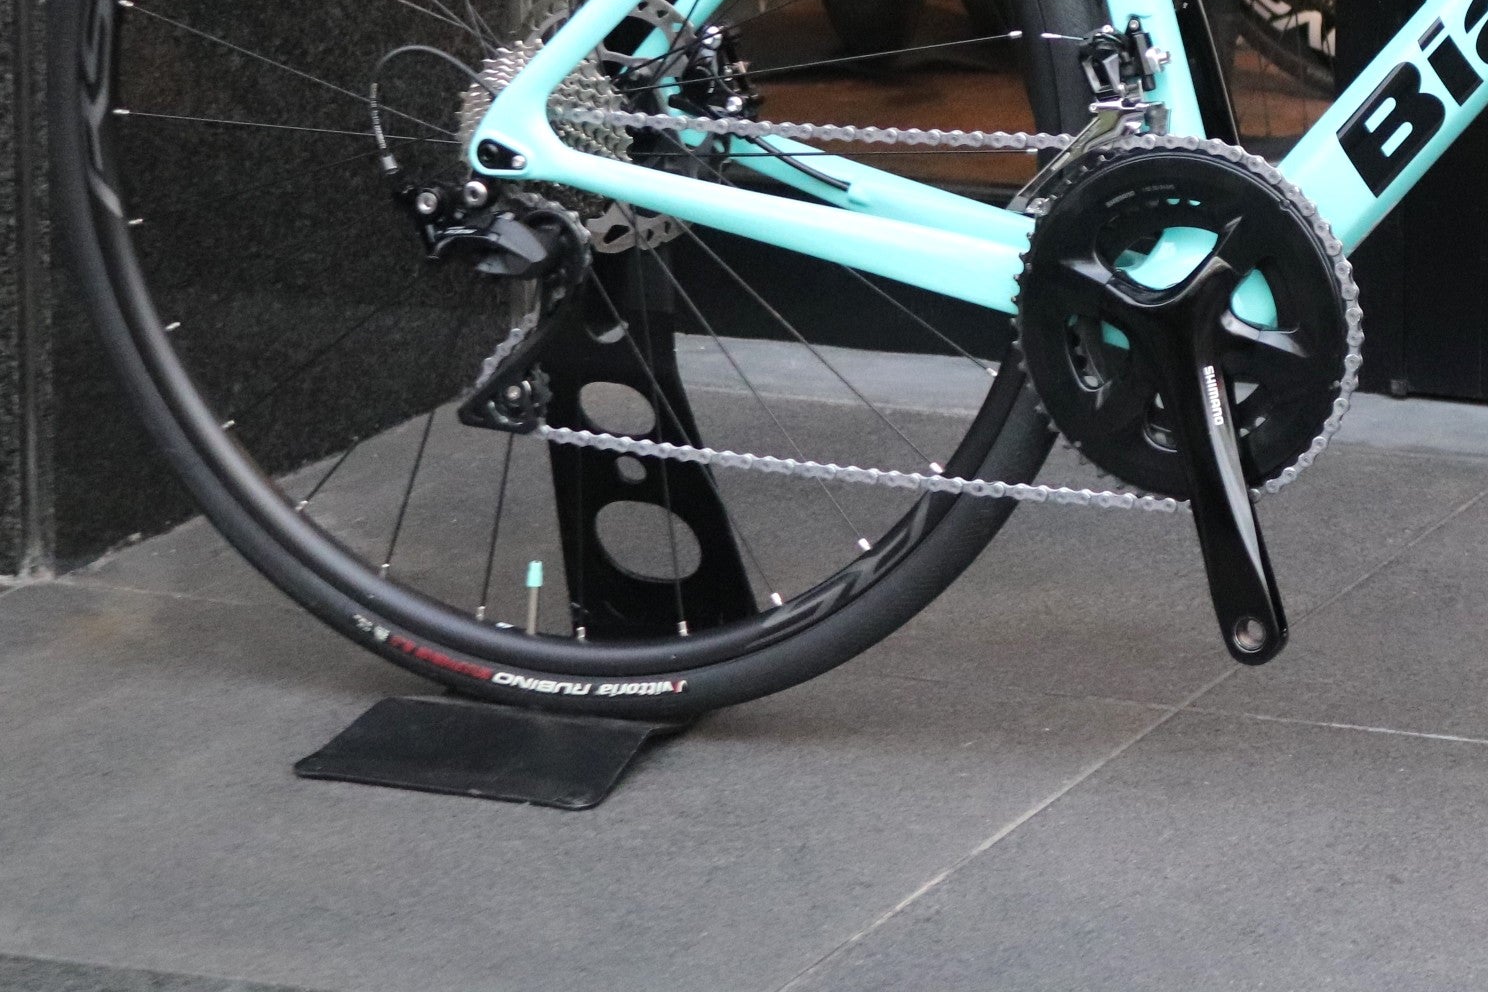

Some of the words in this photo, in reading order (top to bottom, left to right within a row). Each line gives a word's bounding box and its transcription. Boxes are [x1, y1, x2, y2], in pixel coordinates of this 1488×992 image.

[1203, 364, 1224, 427] SHIMANO
[492, 672, 592, 696] RUBINO
[599, 679, 675, 699] vittoria
